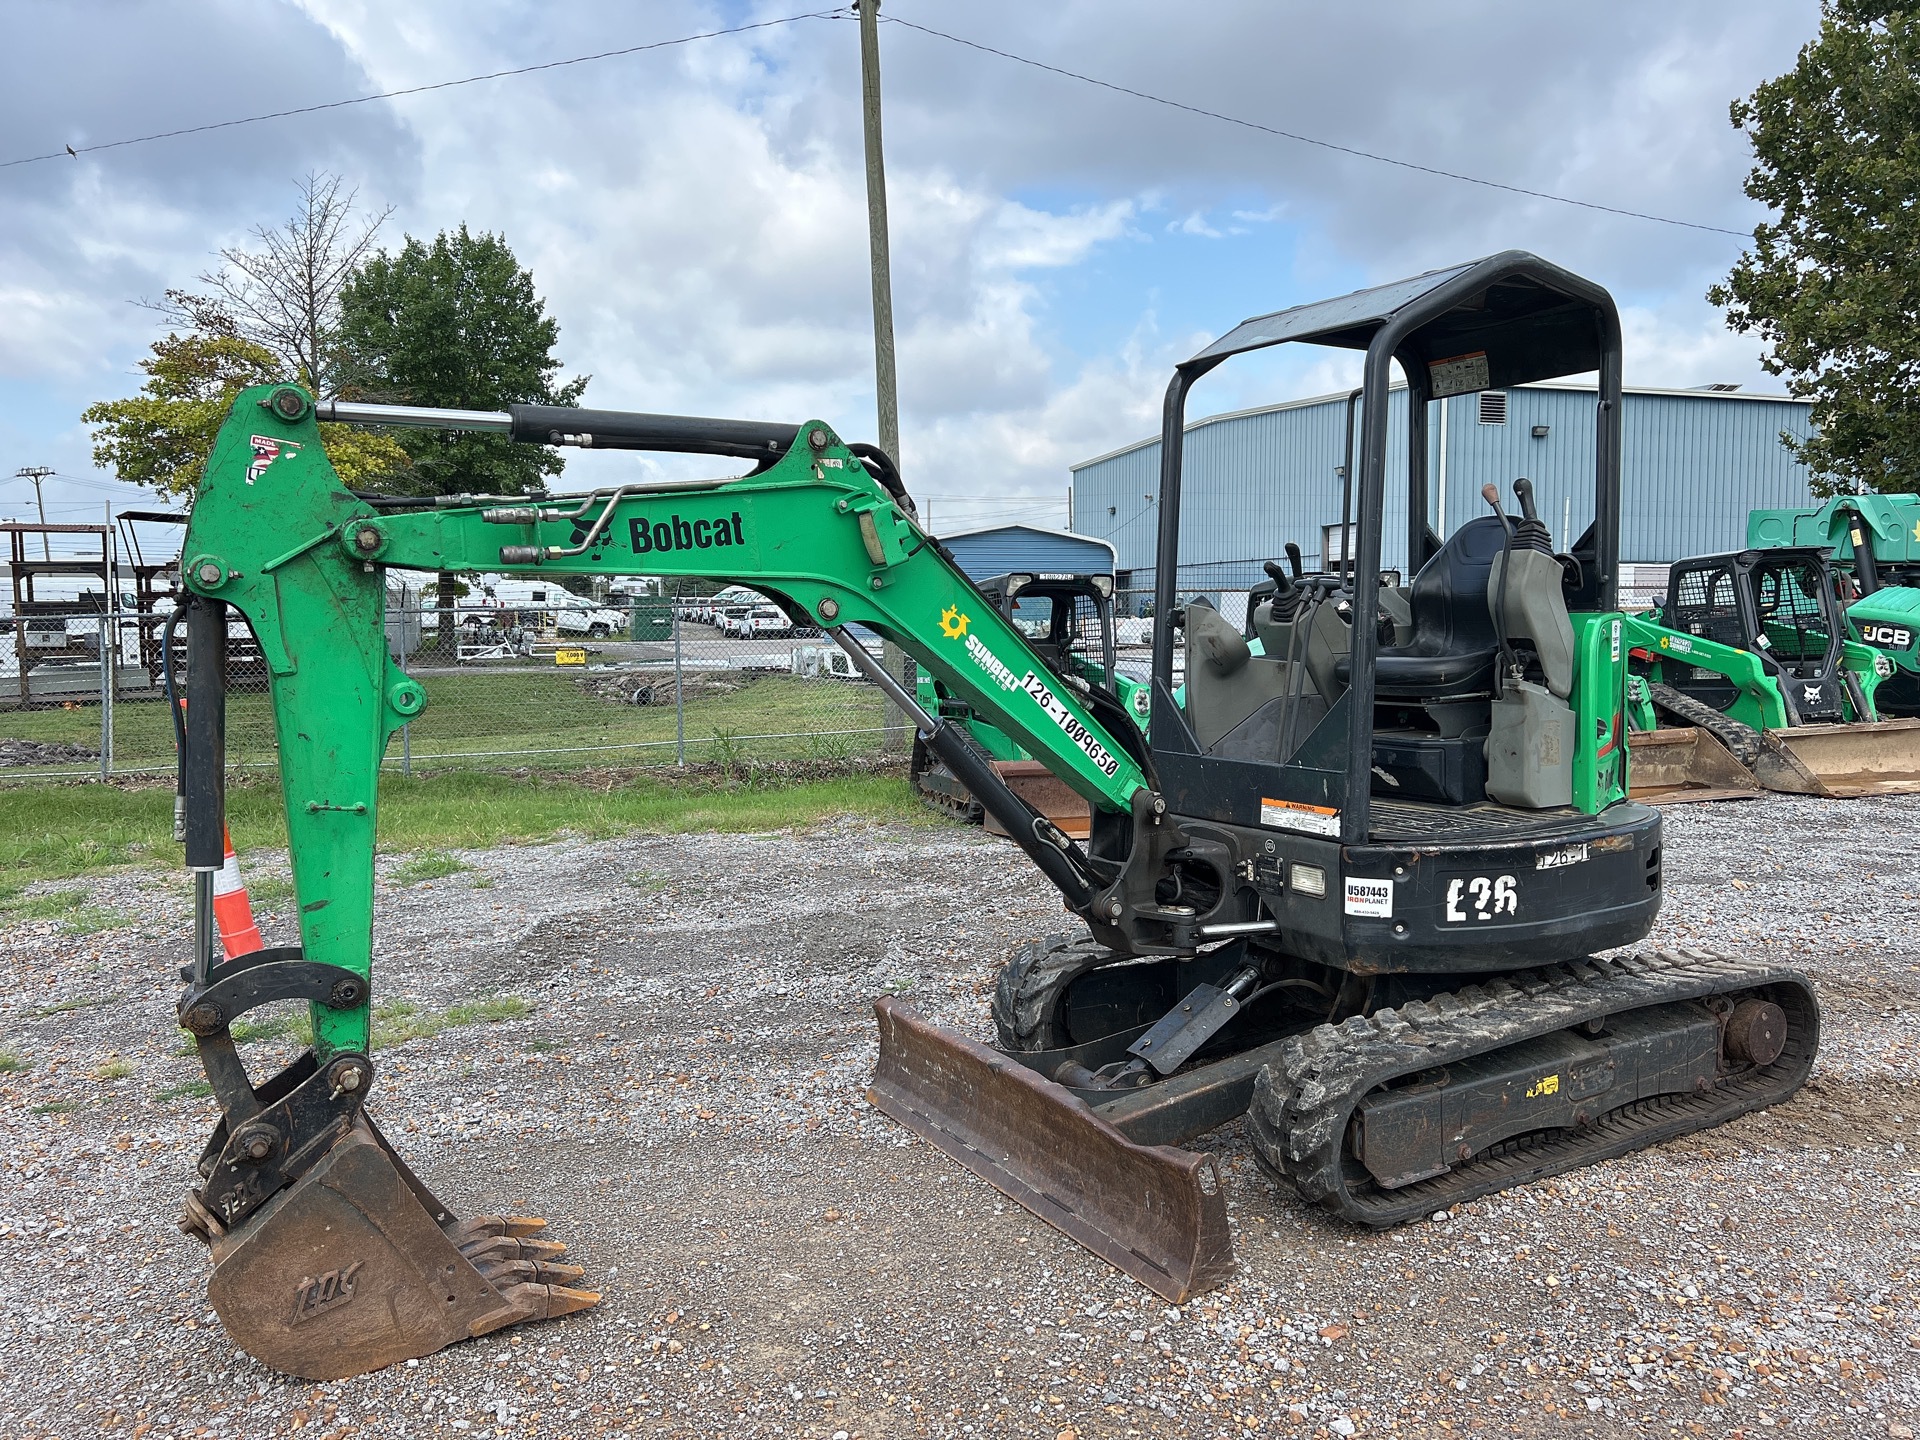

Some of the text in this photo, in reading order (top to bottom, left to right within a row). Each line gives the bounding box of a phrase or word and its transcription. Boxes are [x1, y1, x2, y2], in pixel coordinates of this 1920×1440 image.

[628, 511, 745, 554] Bobcat
[1863, 626, 1910, 645] JCB
[965, 634, 1021, 692] SUNBELT
[1023, 674, 1119, 776] 126-1009650
[1291, 803, 1315, 812] WARNING
[1348, 885, 1388, 897] U587443
[1447, 875, 1517, 922] E26
